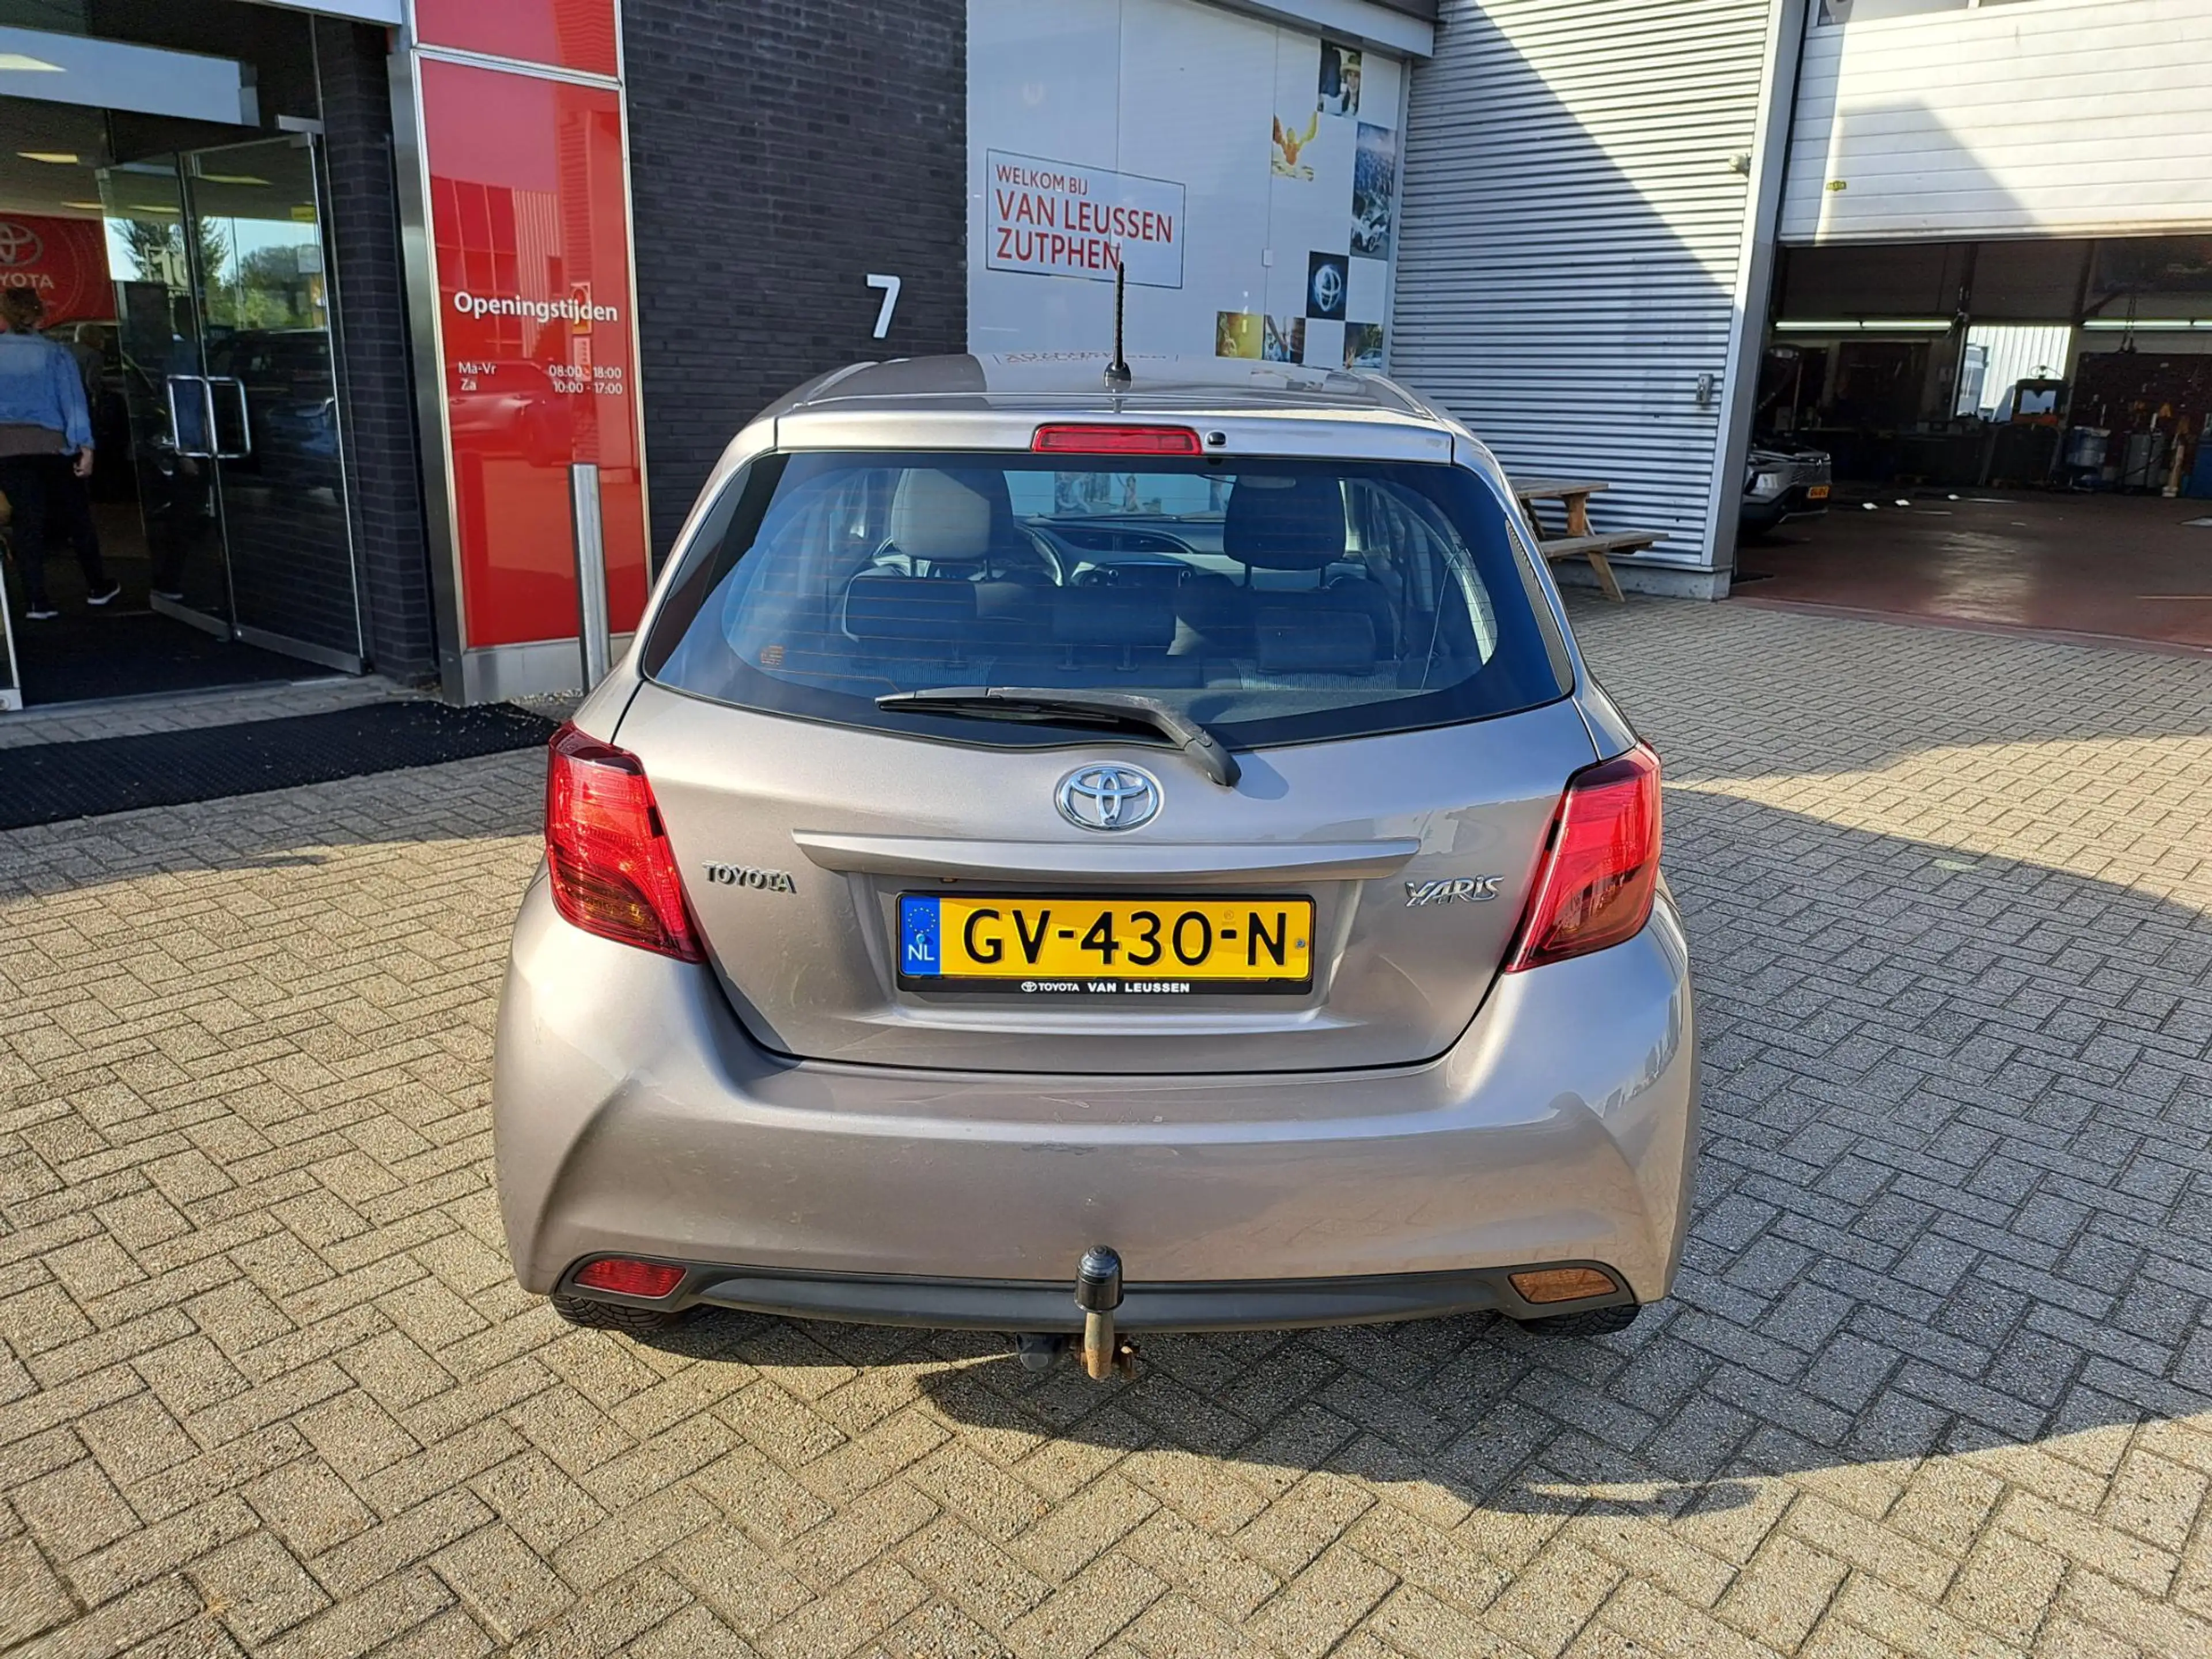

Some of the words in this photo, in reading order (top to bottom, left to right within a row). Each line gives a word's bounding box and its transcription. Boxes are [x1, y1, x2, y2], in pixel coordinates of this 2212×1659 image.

[996, 164, 1065, 192] WELKOM
[1069, 177, 1088, 196] BIJ
[995, 188, 1055, 228] VAN
[1065, 199, 1172, 244] LEUSSEN
[997, 227, 1121, 272] ZUTPHEN
[454, 291, 618, 324] Openingstijden
[866, 274, 901, 339] 7
[458, 362, 496, 375] Ma-Vr
[548, 365, 582, 378] 08:00
[593, 368, 622, 379] 18:00
[461, 378, 477, 391] Za
[554, 381, 583, 393] 10:00
[594, 382, 623, 394] 17:00
[702, 859, 797, 894] TOYOTA
[908, 944, 935, 961] NL
[963, 908, 1287, 966] GV-430-N
[1038, 983, 1080, 991] TOYOTA
[1088, 983, 1116, 993] VAN
[1125, 983, 1190, 993] LEUSSEN
